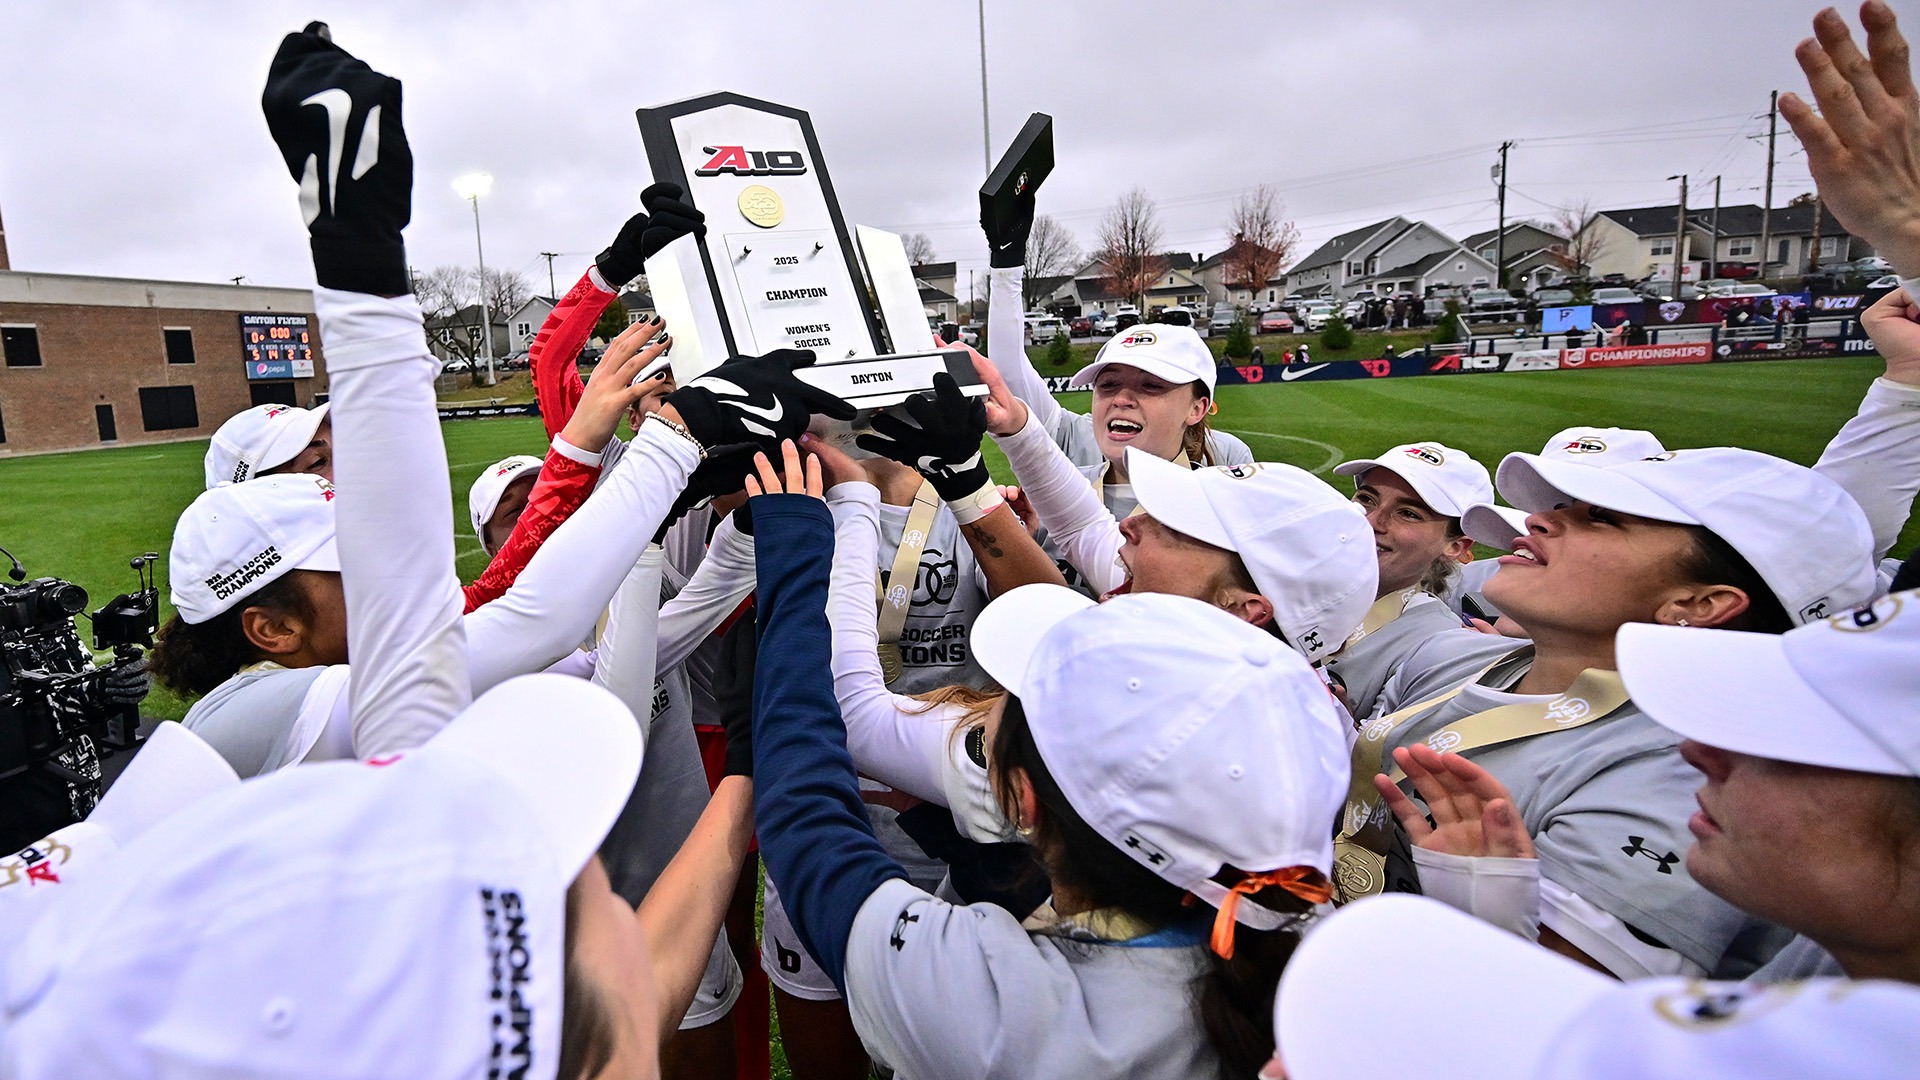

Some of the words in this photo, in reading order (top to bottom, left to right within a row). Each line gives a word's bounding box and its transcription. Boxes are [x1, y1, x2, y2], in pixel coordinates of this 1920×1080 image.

[702, 146, 805, 170] A10
[774, 256, 799, 266] 2025
[766, 287, 828, 302] CHAMPION
[1823, 296, 1861, 310] VCU
[244, 316, 276, 325] DAYTON
[277, 316, 307, 325] FLYERS
[785, 323, 831, 336] WOMEN'S
[794, 337, 831, 349] SOCCER
[1430, 352, 1500, 371] A10
[1589, 346, 1707, 363] CHAMPIONSHIPS
[268, 365, 286, 374] pepsi
[850, 371, 894, 385] DAYTON
[216, 552, 282, 601] CHAMPIONS
[900, 624, 966, 643] SOCCER
